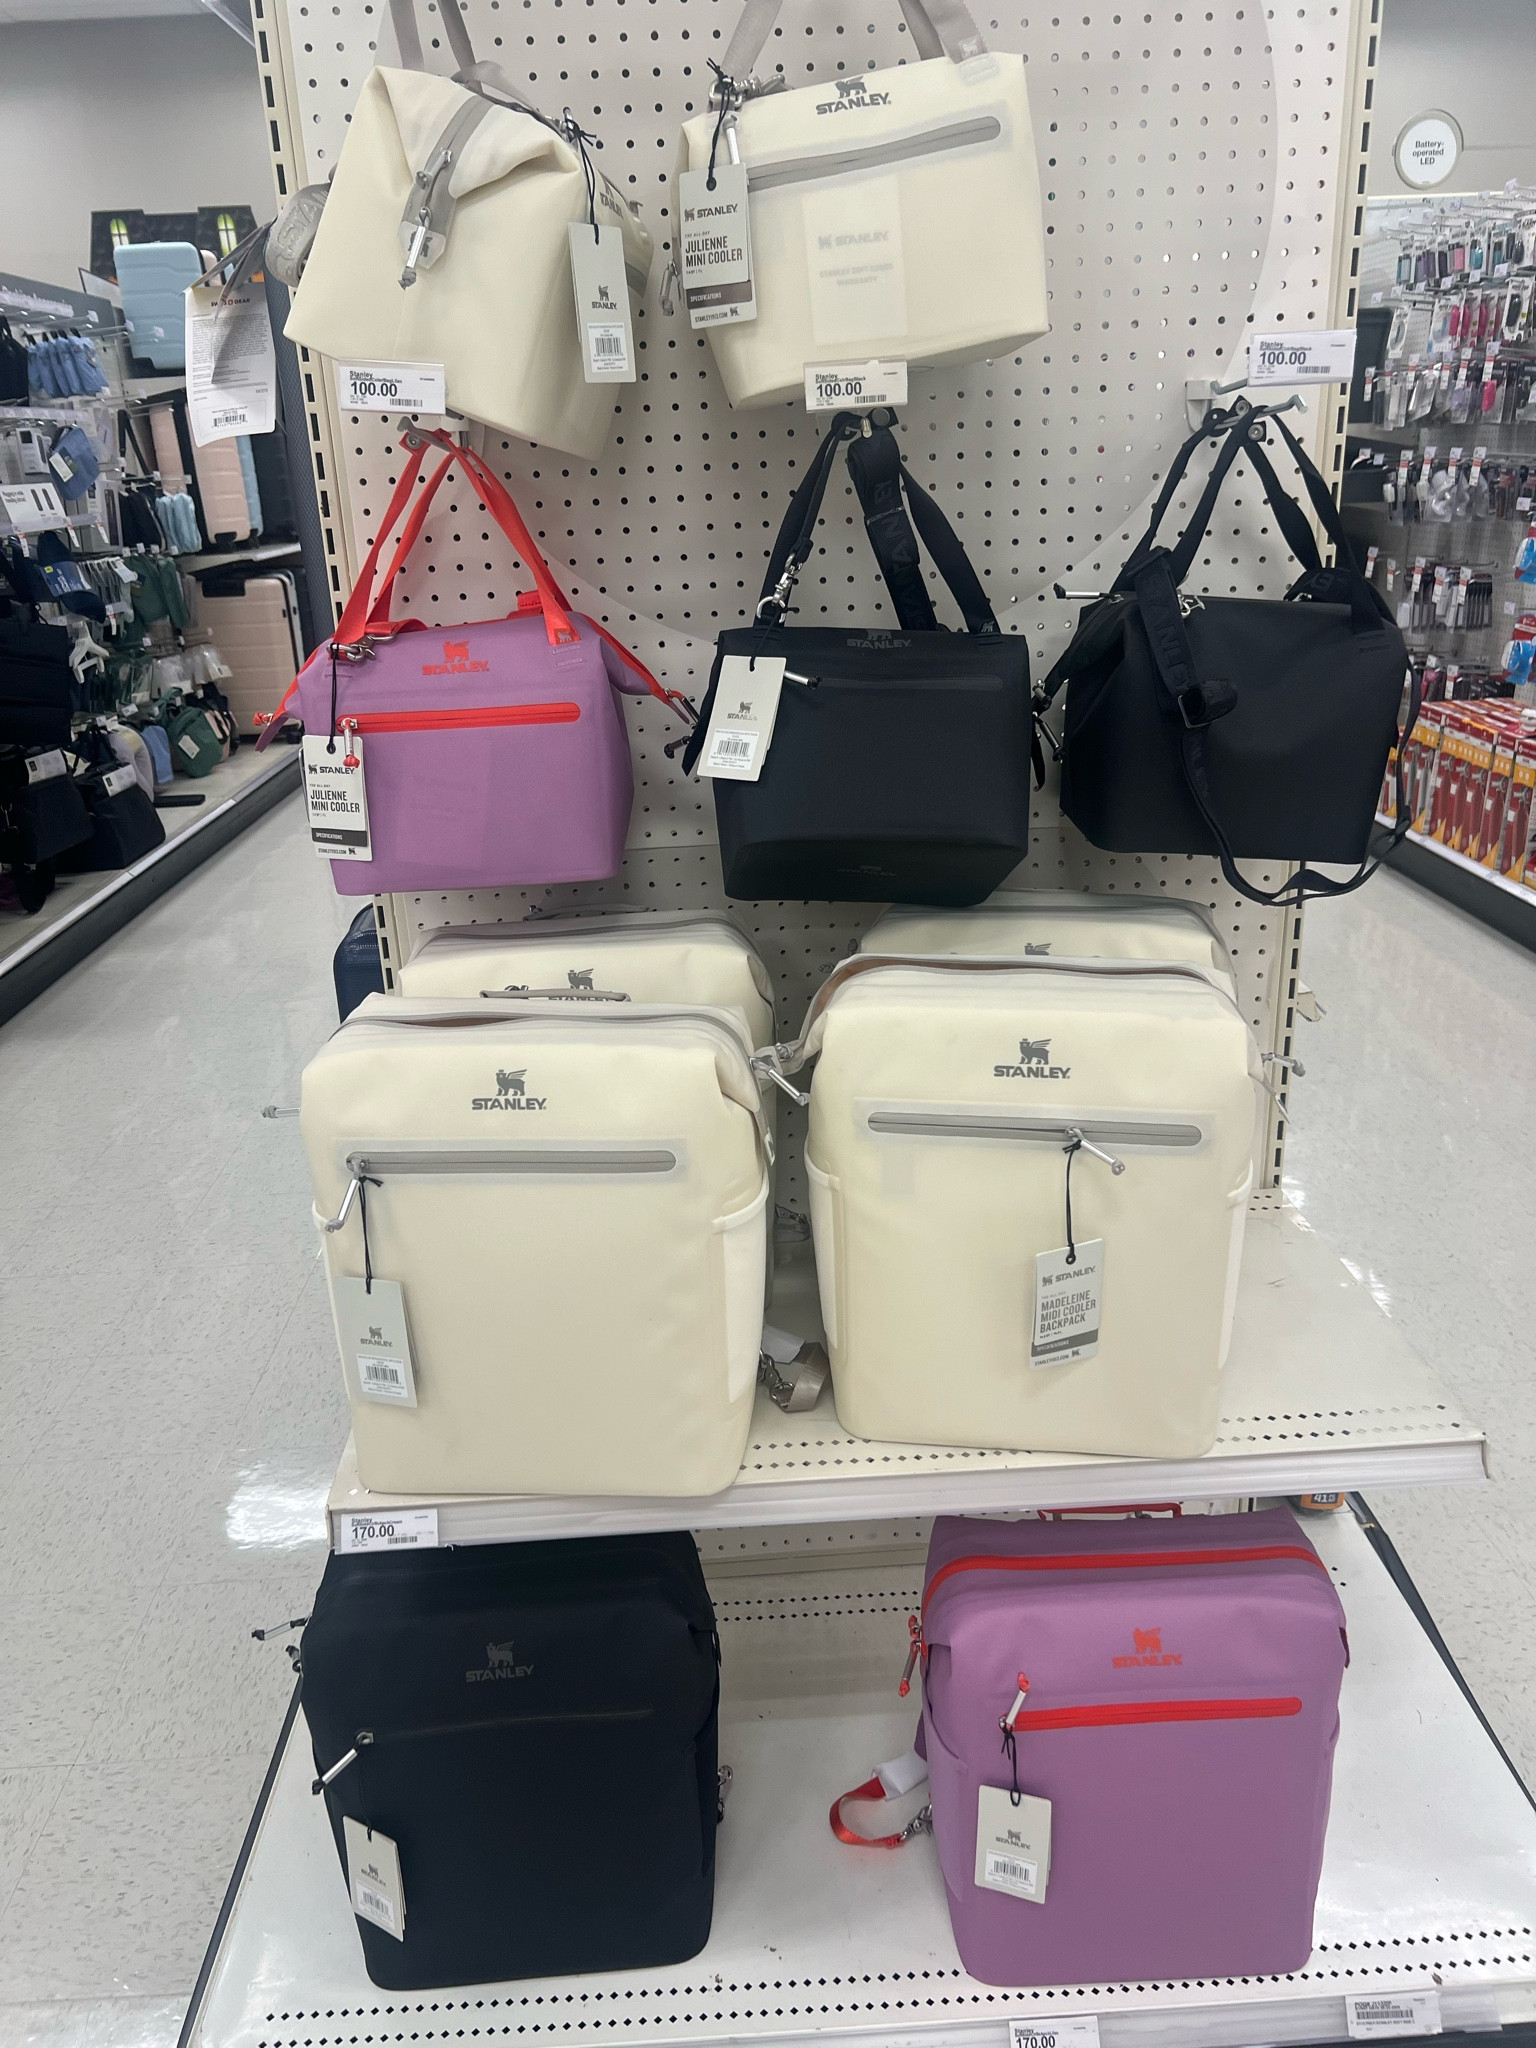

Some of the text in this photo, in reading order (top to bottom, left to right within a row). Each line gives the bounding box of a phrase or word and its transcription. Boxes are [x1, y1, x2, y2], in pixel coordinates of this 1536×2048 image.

[816, 92, 890, 115] STANLEY
[1415, 140, 1444, 148] Battery-
[1412, 148, 1444, 158] operated
[1420, 157, 1436, 165] LED
[697, 203, 738, 218] STANLEY
[685, 236, 728, 253] JULIENNE
[835, 230, 890, 246] STANLEY
[685, 248, 743, 267] MINI COOLER
[591, 301, 617, 310] STANLEY
[1259, 351, 1306, 365] 100.00
[349, 370, 373, 378] Stanley
[351, 381, 398, 397] 100.00
[816, 382, 862, 397] 100.00
[847, 638, 912, 649] STANLEY
[422, 660, 490, 675] STANLEY
[319, 766, 355, 774] STANLEY
[310, 789, 347, 801] JULIENNE
[311, 801, 360, 813] MINI COOLER
[993, 1065, 1071, 1079] STANLEY
[471, 1097, 547, 1110] STANLEY
[1055, 1265, 1096, 1282] STANLEY
[1041, 1290, 1091, 1312] MADELEINE
[1040, 1299, 1096, 1322] MIDI COOLER
[1040, 1313, 1086, 1333] BACKPACK
[360, 1338, 392, 1347] STANLEY
[1314, 1493, 1328, 1503] 41
[352, 1524, 395, 1539] 170.00
[1112, 1653, 1183, 1669] STANLEY
[465, 1664, 535, 1682] STANLEY
[995, 1836, 1031, 1850] STANLEY
[1016, 2035, 1056, 2048] 170.00
